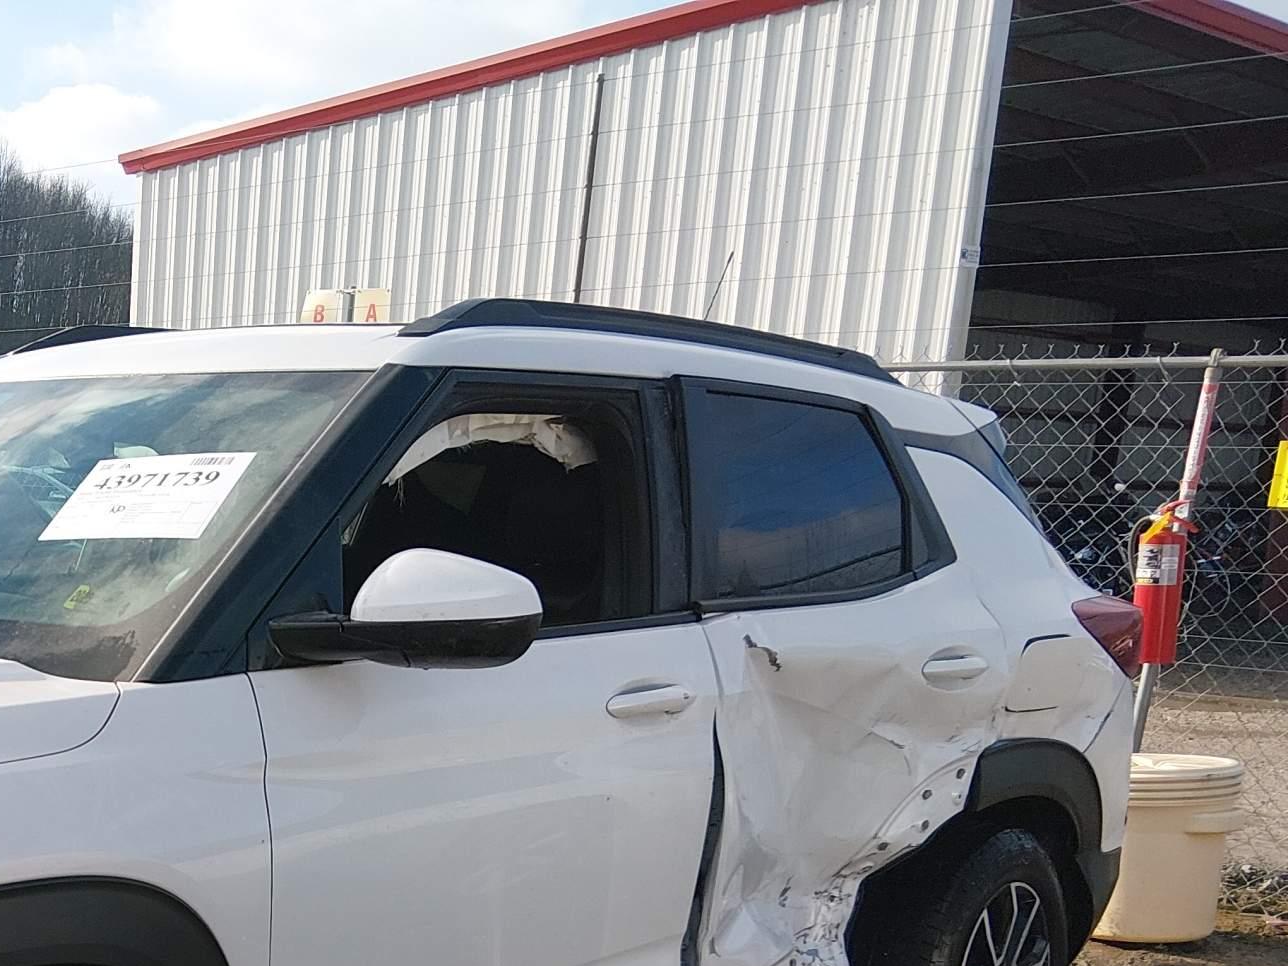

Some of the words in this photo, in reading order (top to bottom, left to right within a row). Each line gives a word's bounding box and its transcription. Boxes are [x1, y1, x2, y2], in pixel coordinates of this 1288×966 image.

[313, 304, 325, 323] B
[365, 303, 377, 323] A
[94, 470, 221, 490] 43971739
